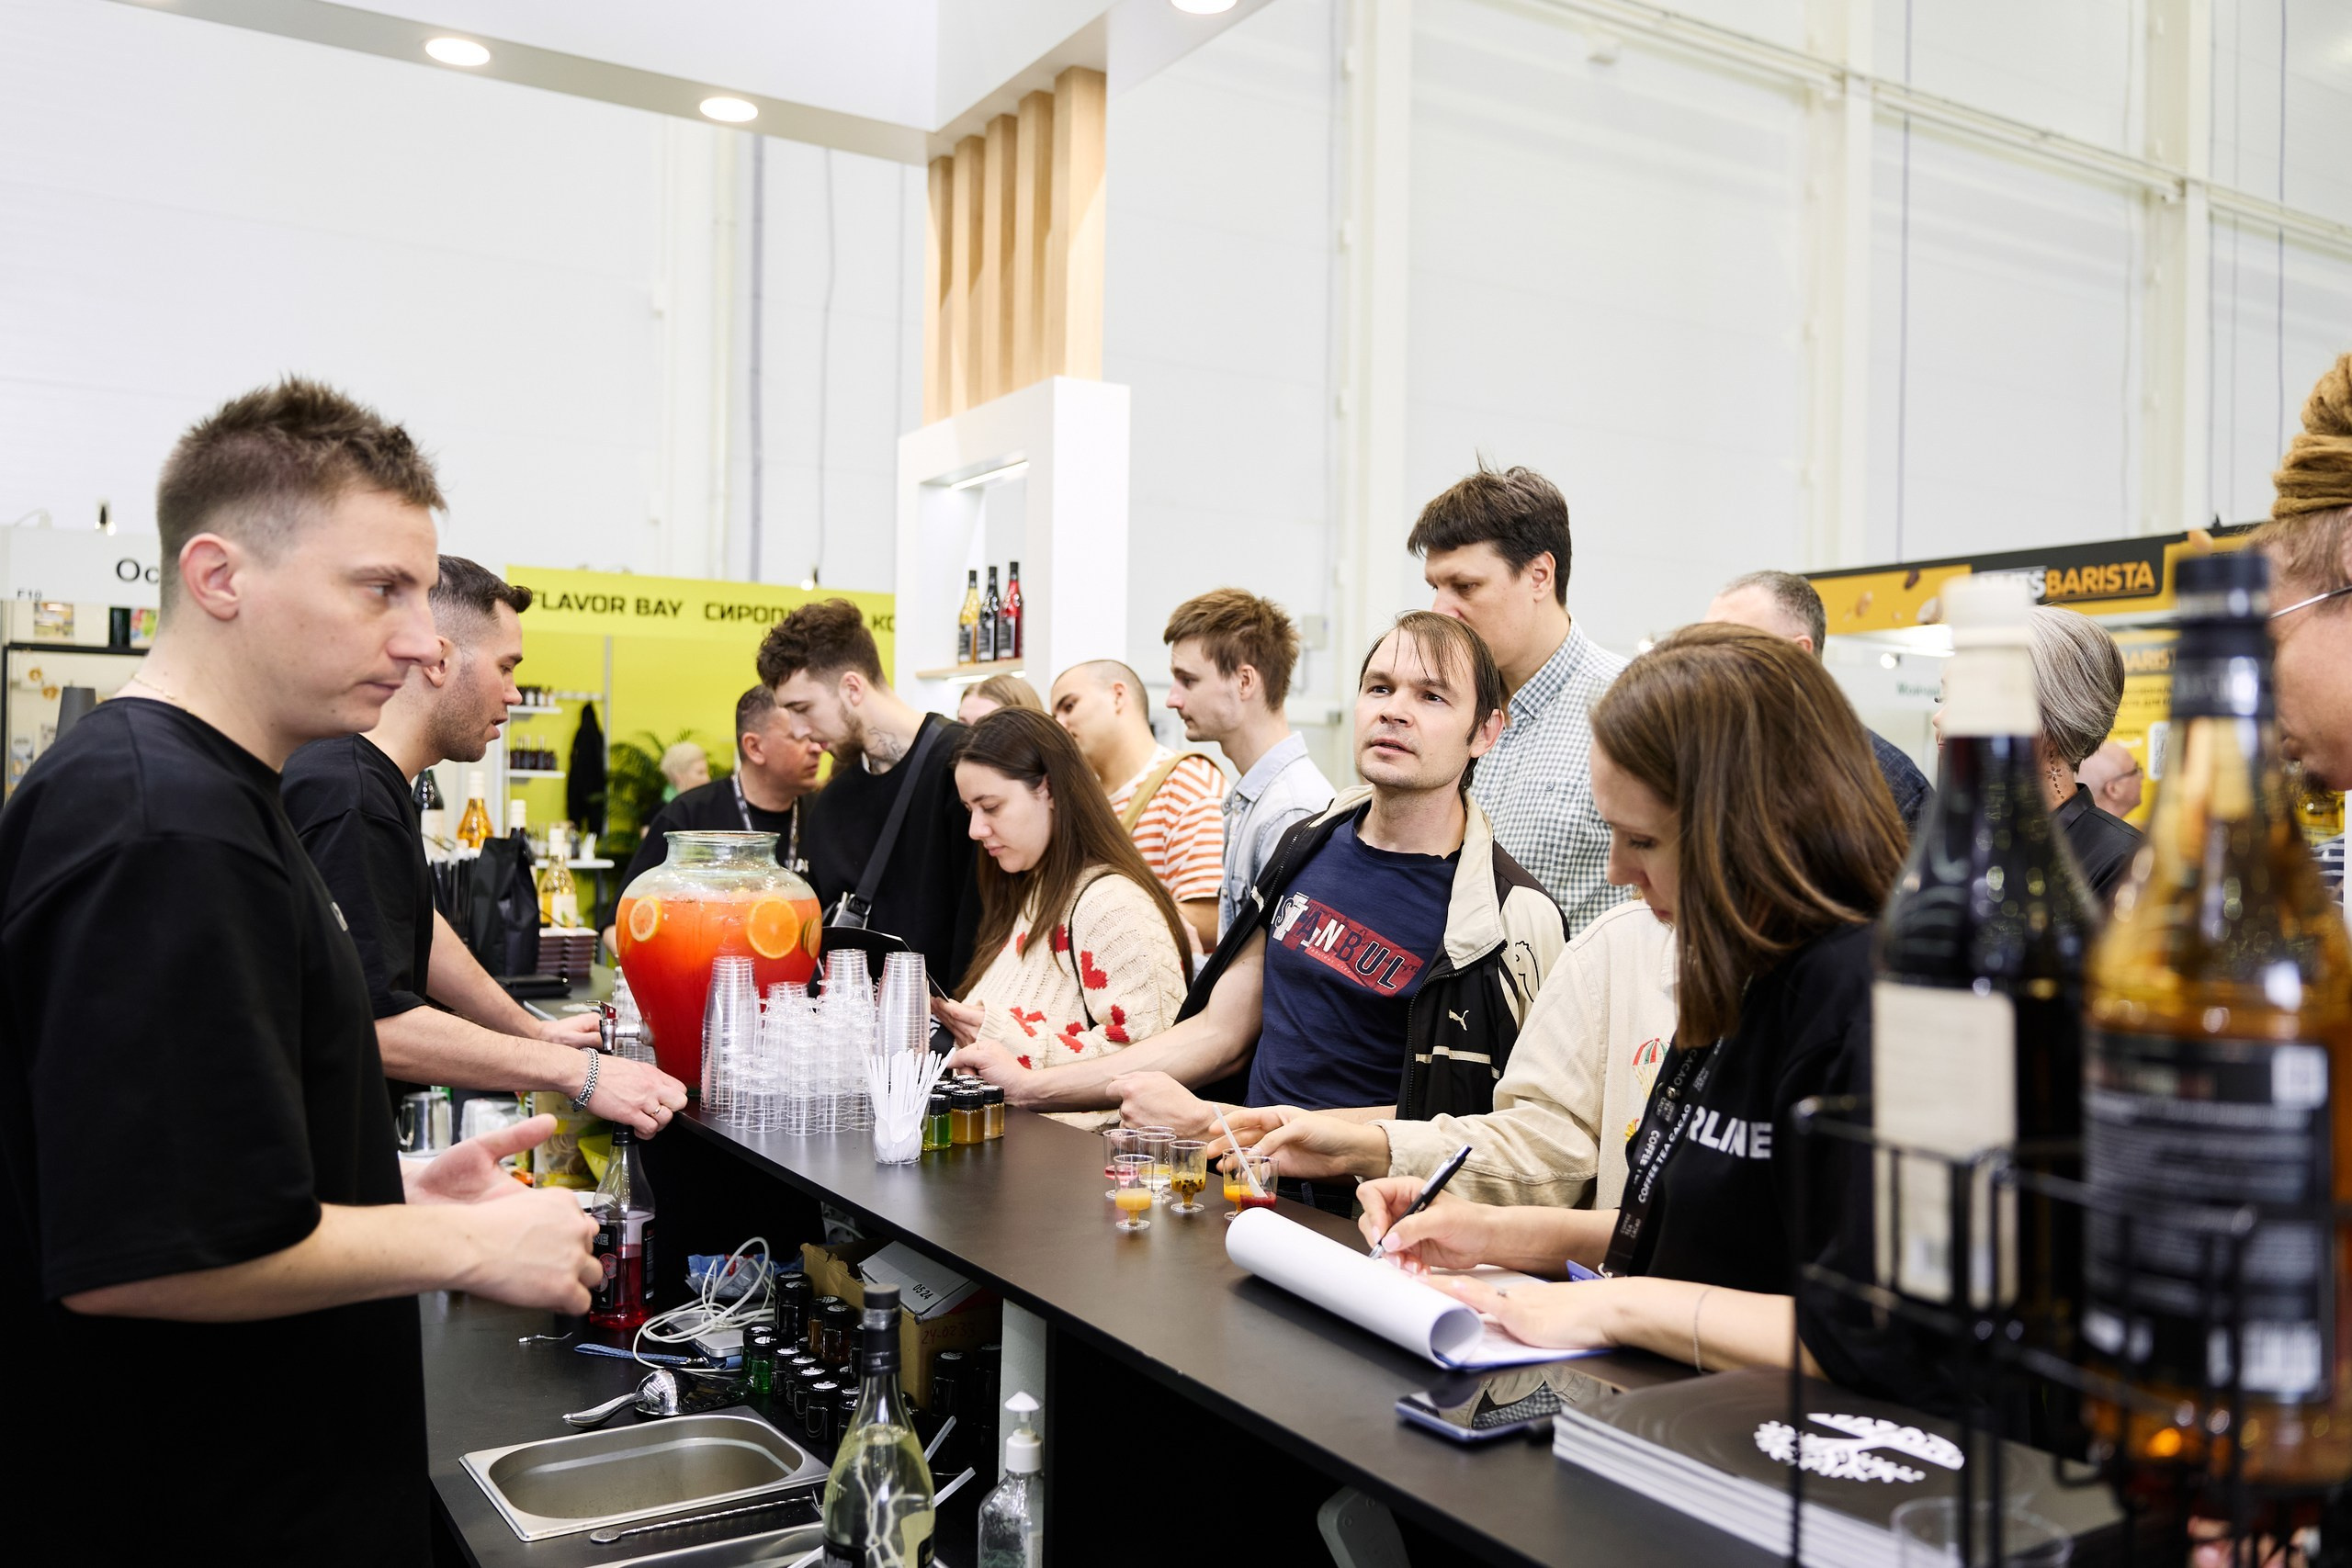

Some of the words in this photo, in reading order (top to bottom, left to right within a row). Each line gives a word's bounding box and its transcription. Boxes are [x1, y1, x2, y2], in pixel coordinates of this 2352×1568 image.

[1975, 560, 2156, 599] SBARISTA
[636, 597, 683, 617] BAY
[705, 602, 790, 624] СИРОП
[1272, 892, 1406, 990] ISTANBUL
[1673, 1049, 1698, 1088] CACAO
[1638, 1164, 1660, 1204] COFFEE
[1656, 1143, 1672, 1166] TEA
[1668, 1103, 1692, 1142] CACAO
[1639, 1130, 1660, 1167] COFFEE
